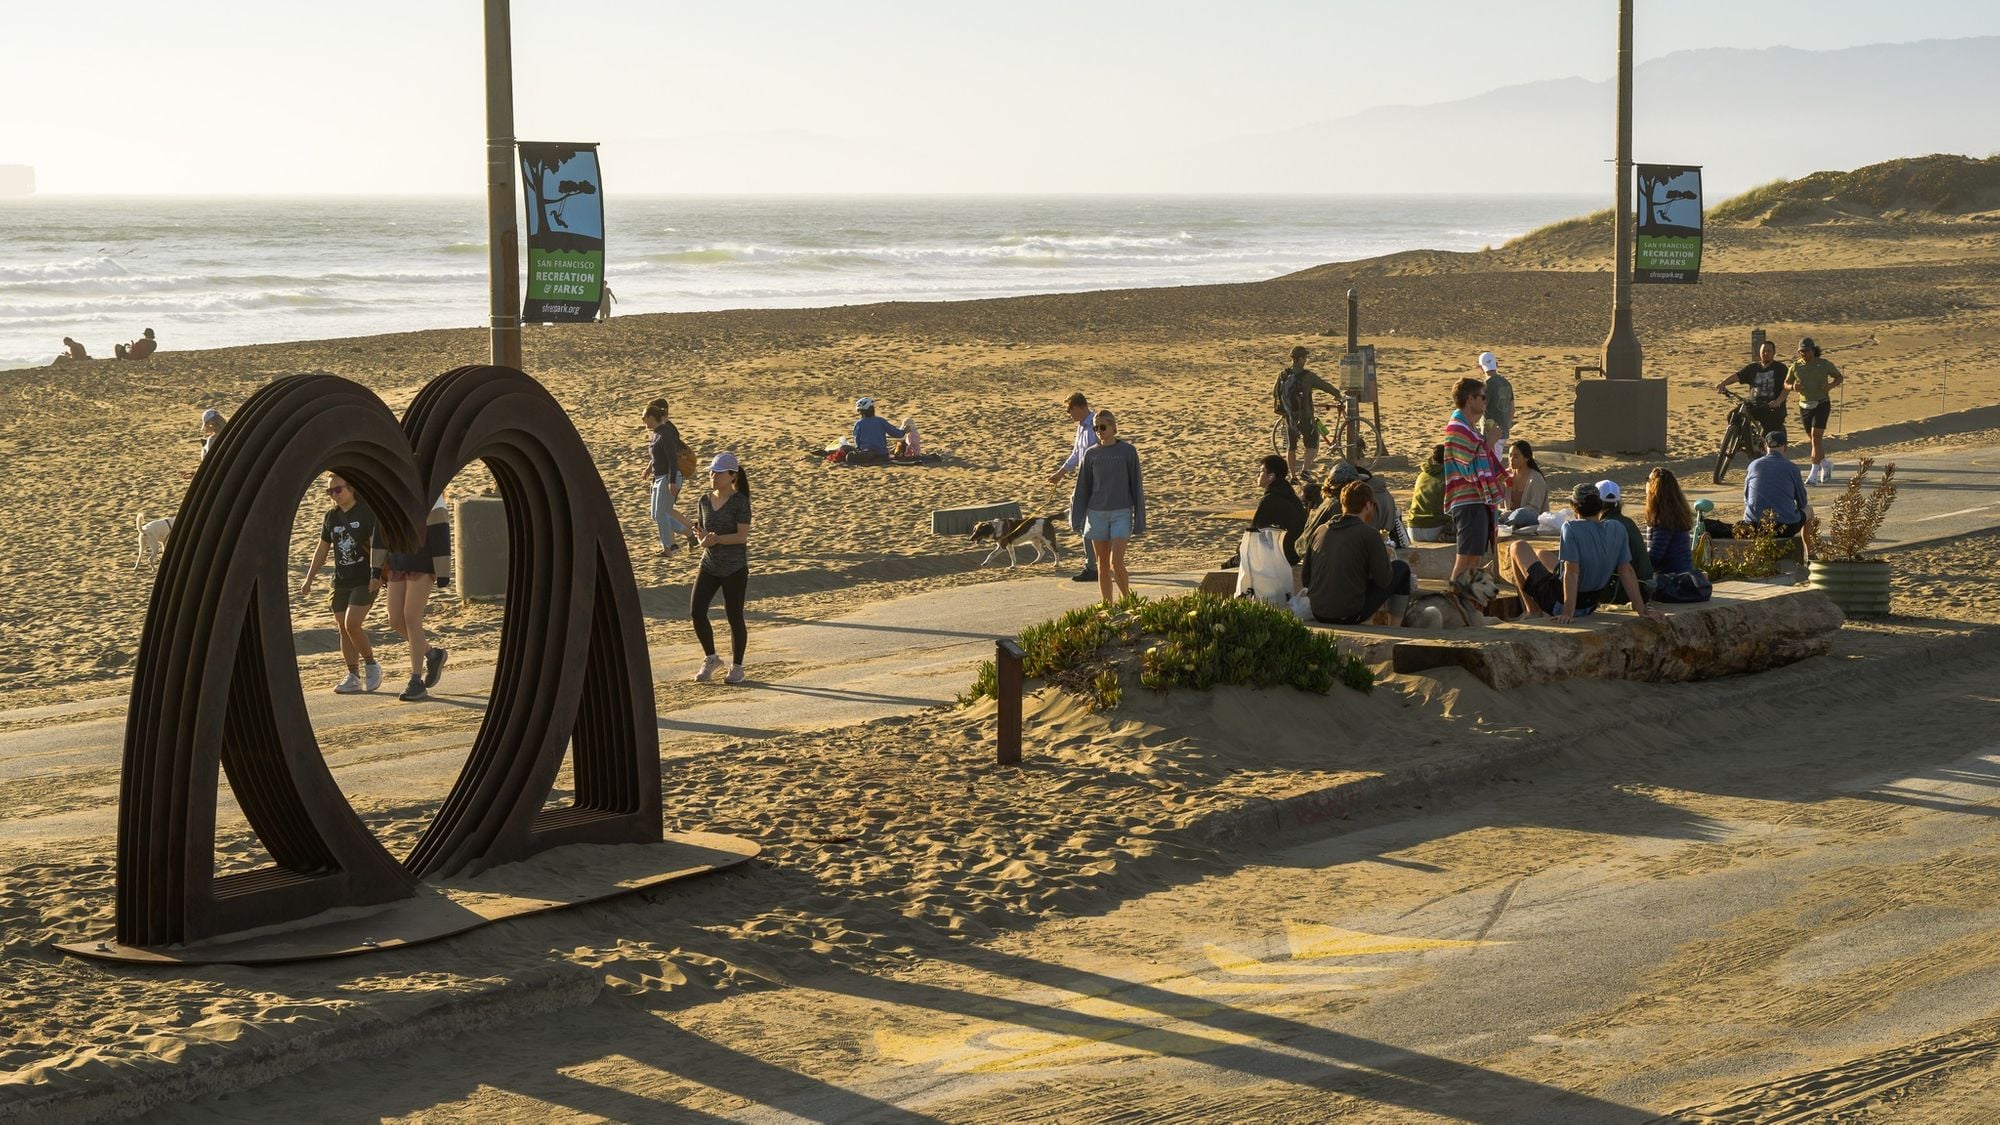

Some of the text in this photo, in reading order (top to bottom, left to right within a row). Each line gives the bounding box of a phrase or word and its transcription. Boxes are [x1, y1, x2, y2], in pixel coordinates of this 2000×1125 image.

[1643, 250, 1694, 258] RECREATION
[537, 260, 594, 269] SAN FRANCISCO
[536, 271, 594, 283] RECREATION
[544, 284, 584, 295] & PARKS
